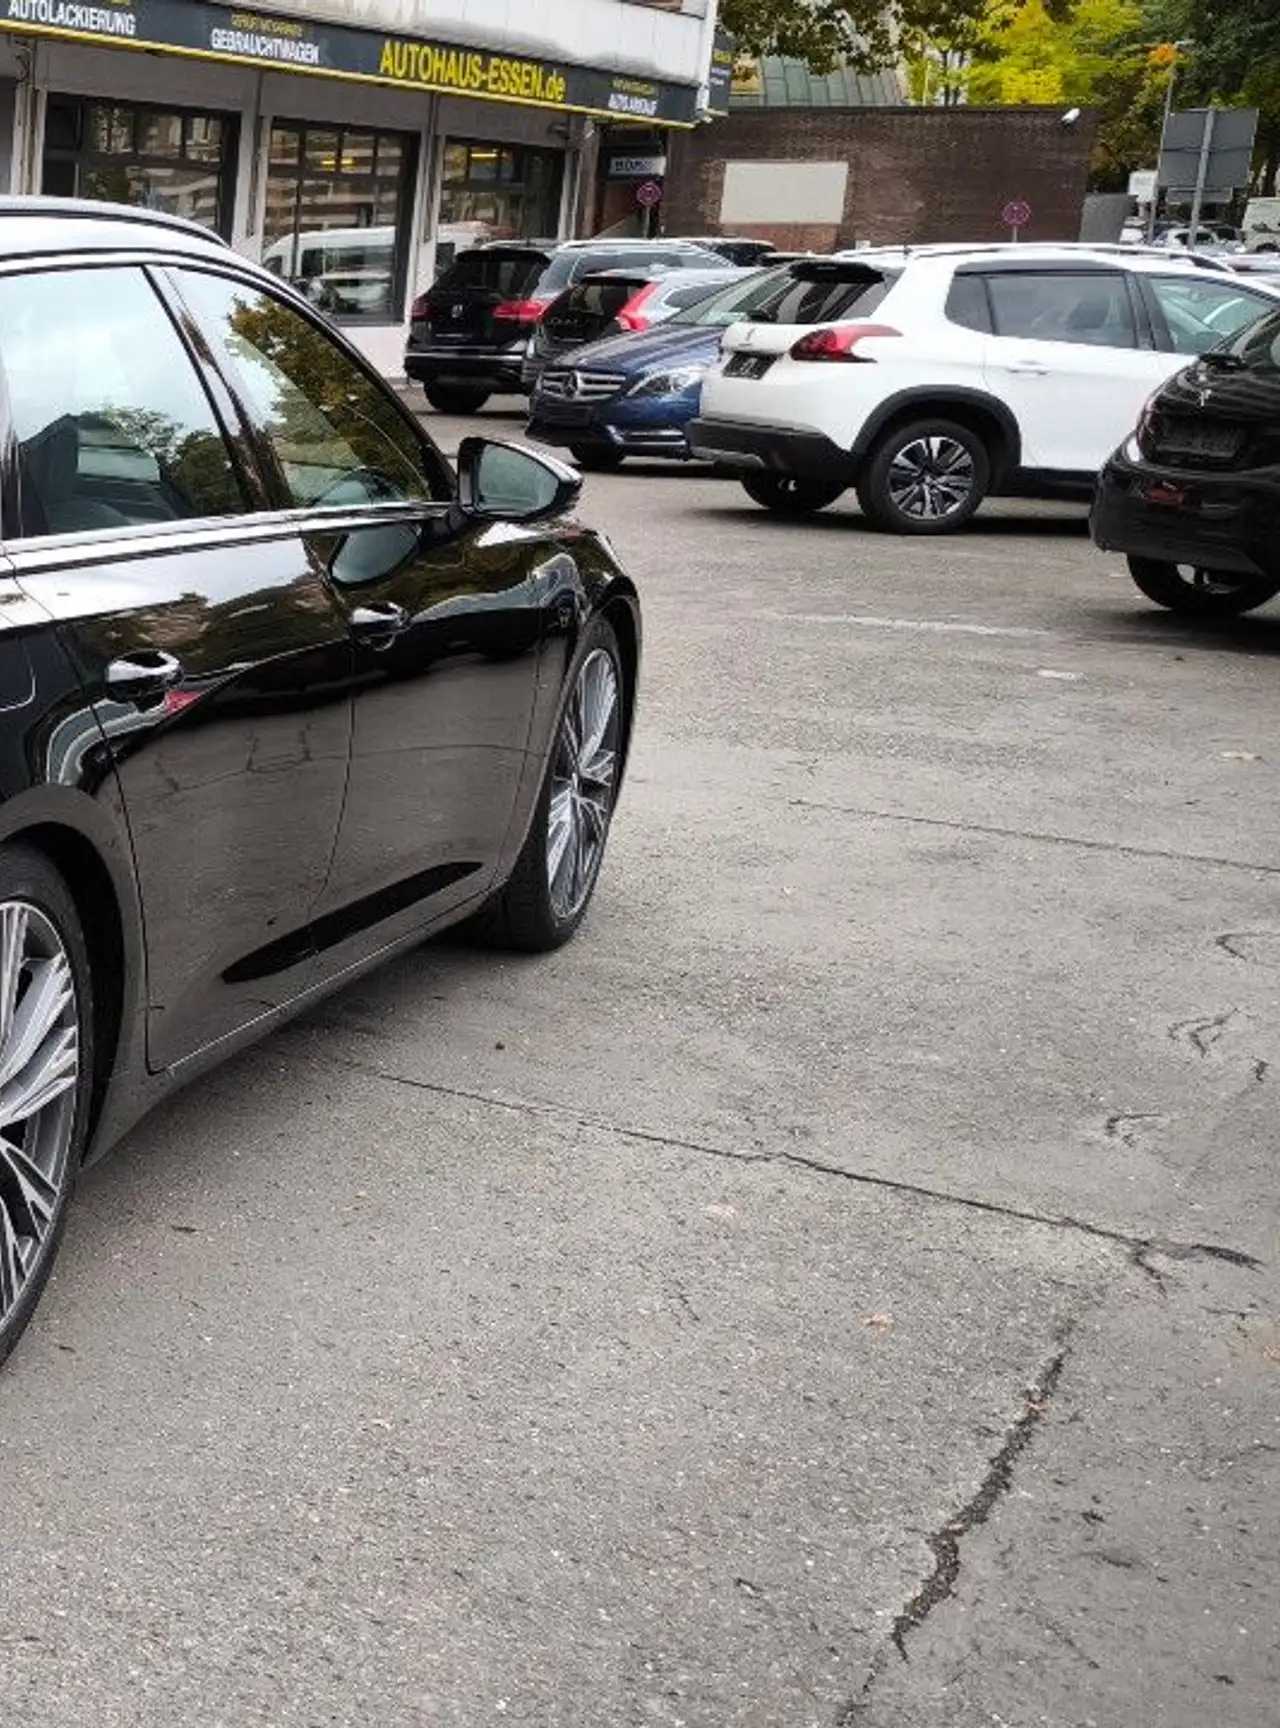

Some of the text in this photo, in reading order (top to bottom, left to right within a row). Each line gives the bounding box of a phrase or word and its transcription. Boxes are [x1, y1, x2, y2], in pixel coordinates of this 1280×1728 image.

[8, 0, 137, 36] AUTOLACKIERUNG
[211, 27, 320, 64] GEBRAUCHTWAGEN
[379, 39, 567, 100] AUTOHAUS-ESSEN.de
